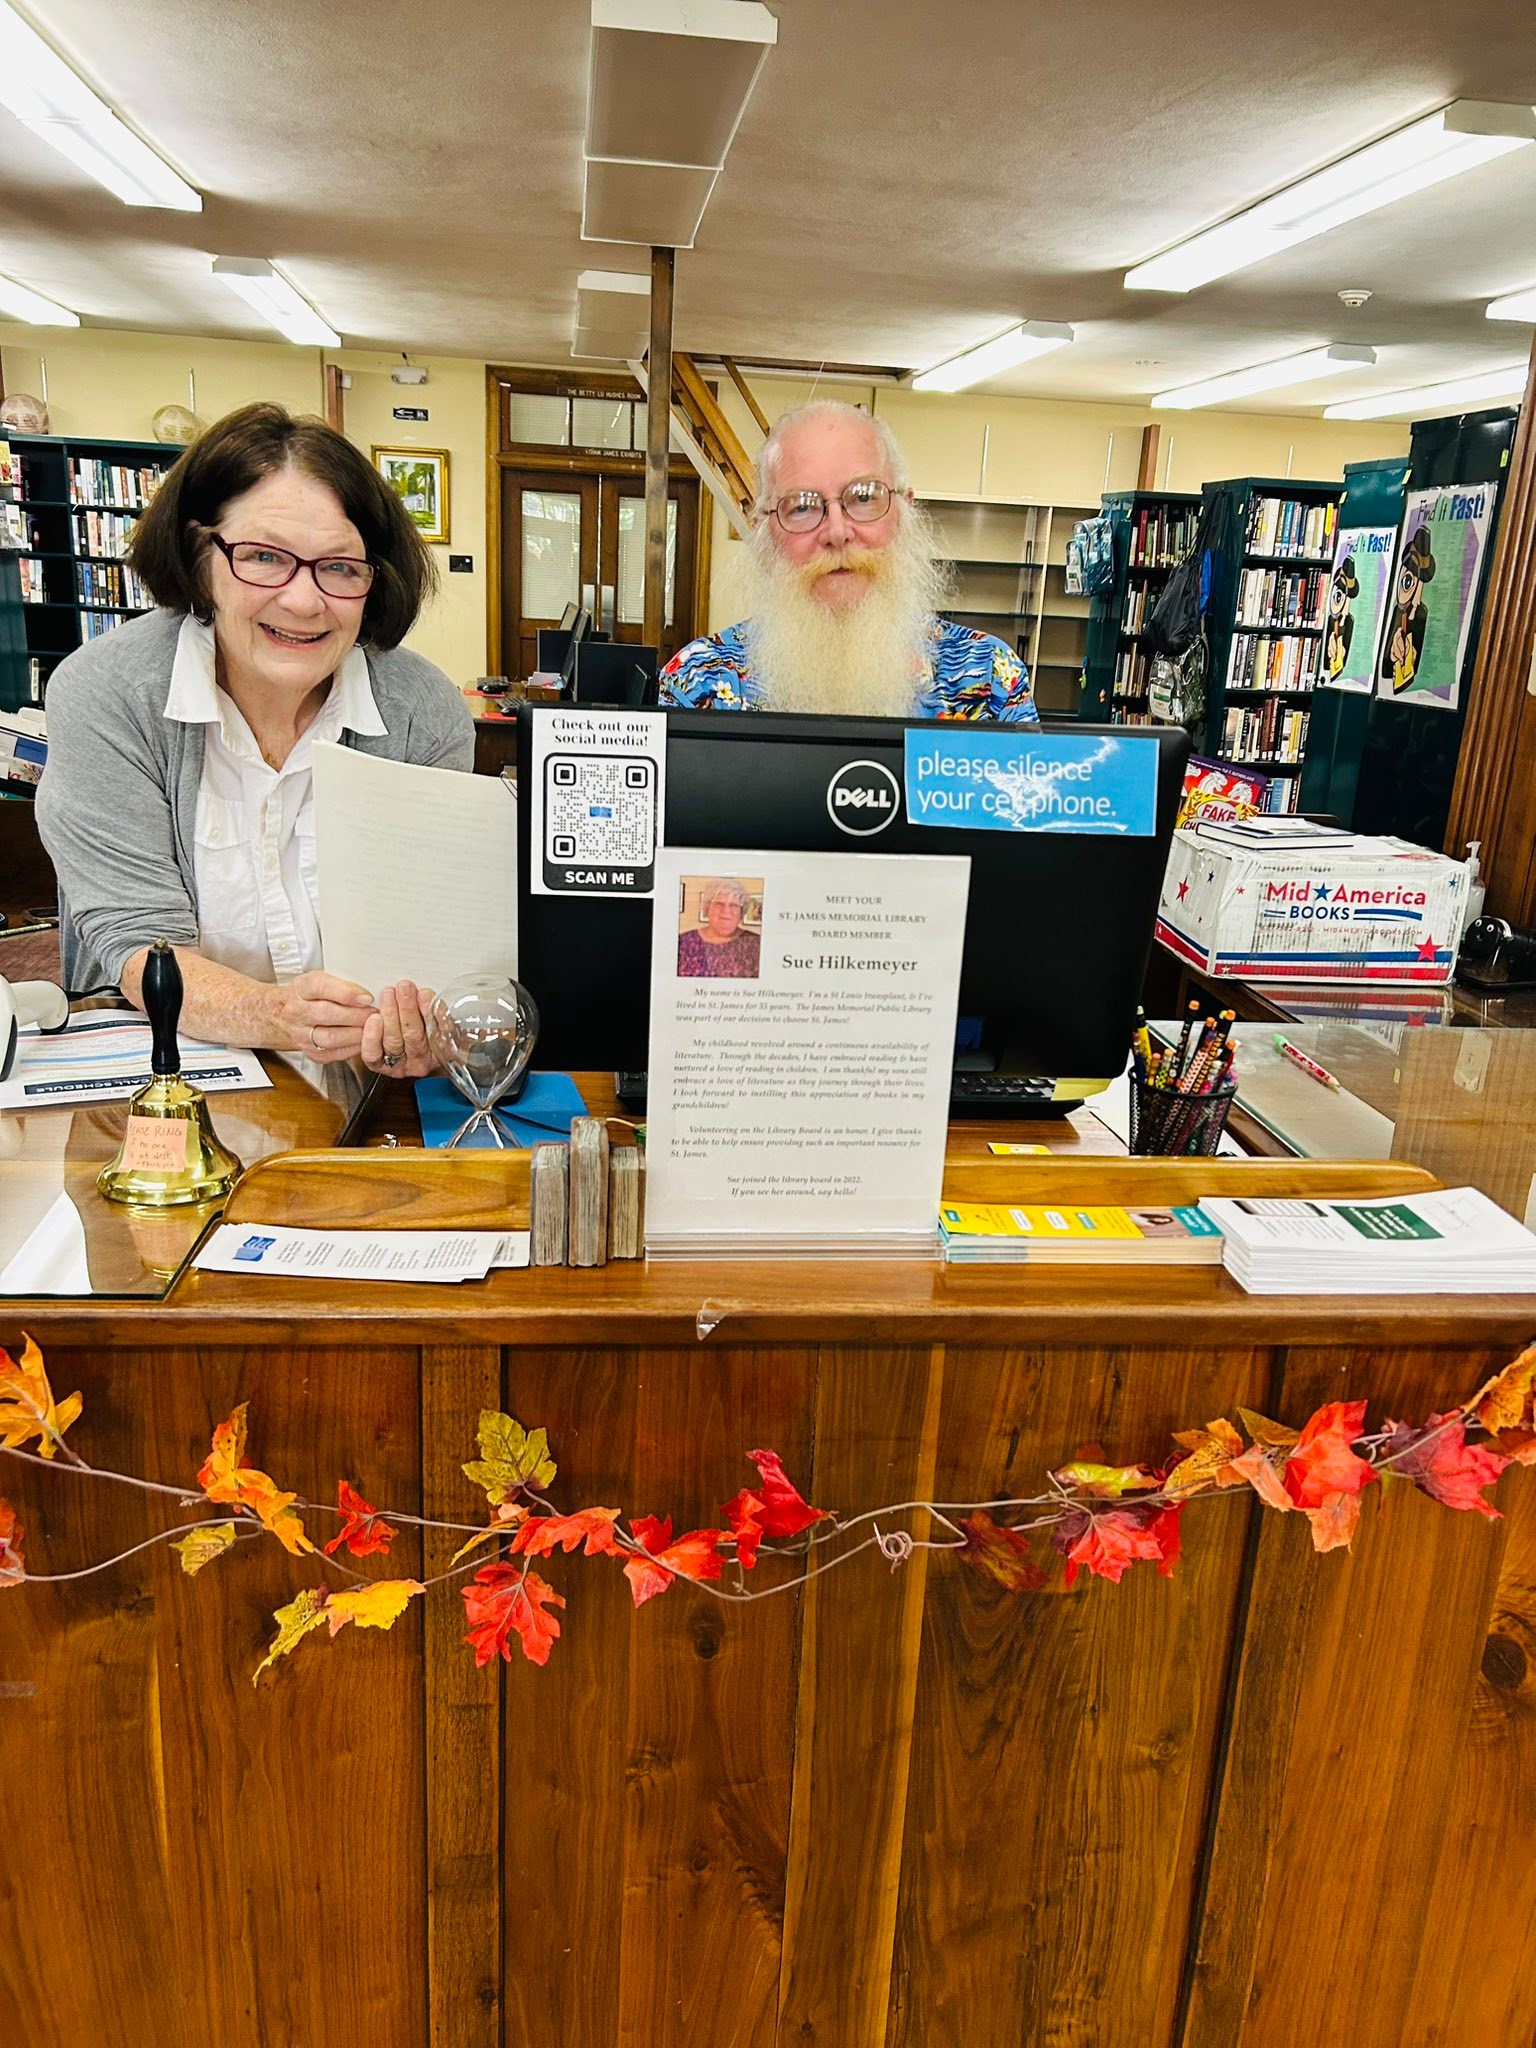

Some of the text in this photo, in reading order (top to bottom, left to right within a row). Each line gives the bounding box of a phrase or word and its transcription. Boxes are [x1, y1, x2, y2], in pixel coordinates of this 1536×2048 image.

[1418, 492, 1485, 522] Find It Fast!
[1367, 532, 1392, 552] Fast!
[552, 718, 652, 733] Check out our
[554, 734, 648, 747] social media!
[918, 750, 1093, 782] please silence
[1232, 771, 1255, 782] SUTHERLAND
[834, 786, 892, 809] DELL
[917, 785, 1117, 819] your ce phone.
[1201, 804, 1237, 822] FAKE
[564, 870, 635, 885] SCAN ME
[1266, 880, 1426, 906] Mid America
[826, 896, 852, 904] MEET
[795, 913, 826, 921] JAMES
[829, 913, 882, 922] MEMORIAL
[885, 914, 927, 923] LIBRARY
[1289, 906, 1350, 920] BOOKS
[812, 931, 891, 939] BOARD MEMBER
[782, 955, 918, 975] Sue Hilkemeyer
[742, 989, 756, 997] Sue
[758, 989, 804, 1000] Hilkemeyer.
[841, 990, 862, 999] Louis
[864, 991, 907, 1002] transplant,
[676, 1000, 696, 1009] lived
[708, 1001, 719, 1009] St.
[720, 1001, 743, 1012] James
[745, 1001, 757, 1012] for
[770, 1004, 792, 1012] years.
[797, 1002, 809, 1011] The
[812, 1002, 835, 1013] James
[836, 1003, 874, 1012] Memorial
[877, 1004, 900, 1012] Public
[902, 1004, 931, 1015] Library
[694, 1013, 711, 1023] part
[738, 1013, 770, 1022] decision
[782, 1014, 809, 1023] choose
[811, 1014, 821, 1023] St.
[823, 1015, 850, 1025] James!
[708, 1039, 749, 1048] childhood
[751, 1040, 785, 1048] revolved
[787, 1040, 816, 1048] around
[825, 1040, 869, 1049] continuous
[871, 1041, 918, 1052] availability
[675, 1050, 927, 1064] literature. Through the decades, have embraced reading have
[674, 1063, 707, 1072] nurtured
[717, 1064, 733, 1072] love
[745, 1064, 775, 1074] reading
[786, 1064, 818, 1073] children.
[843, 1065, 876, 1075] thankful
[911, 1065, 927, 1074] still
[36, 1083, 112, 1092] SCHEDULE
[673, 1075, 925, 1088] embrace love literature they journey through their lives.
[681, 1088, 897, 1100] look forward instilling this appreciation books
[672, 1100, 729, 1111] grandchildren!
[154, 1124, 182, 1138] RING
[689, 1125, 922, 1136] Volunteering the Library Board honor. give thanks
[693, 1137, 710, 1145] able
[721, 1137, 739, 1148] help
[766, 1137, 804, 1148] providing
[805, 1138, 822, 1146] such
[836, 1138, 875, 1148] important
[909, 1138, 921, 1148] for
[671, 1149, 708, 1160] St. James.
[727, 1174, 862, 1185] Sue joined the library board 2022.
[740, 1189, 755, 1197] you
[771, 1187, 784, 1195] her
[786, 1187, 816, 1196] around,
[818, 1189, 832, 1197] say
[834, 1187, 857, 1195] hello!
